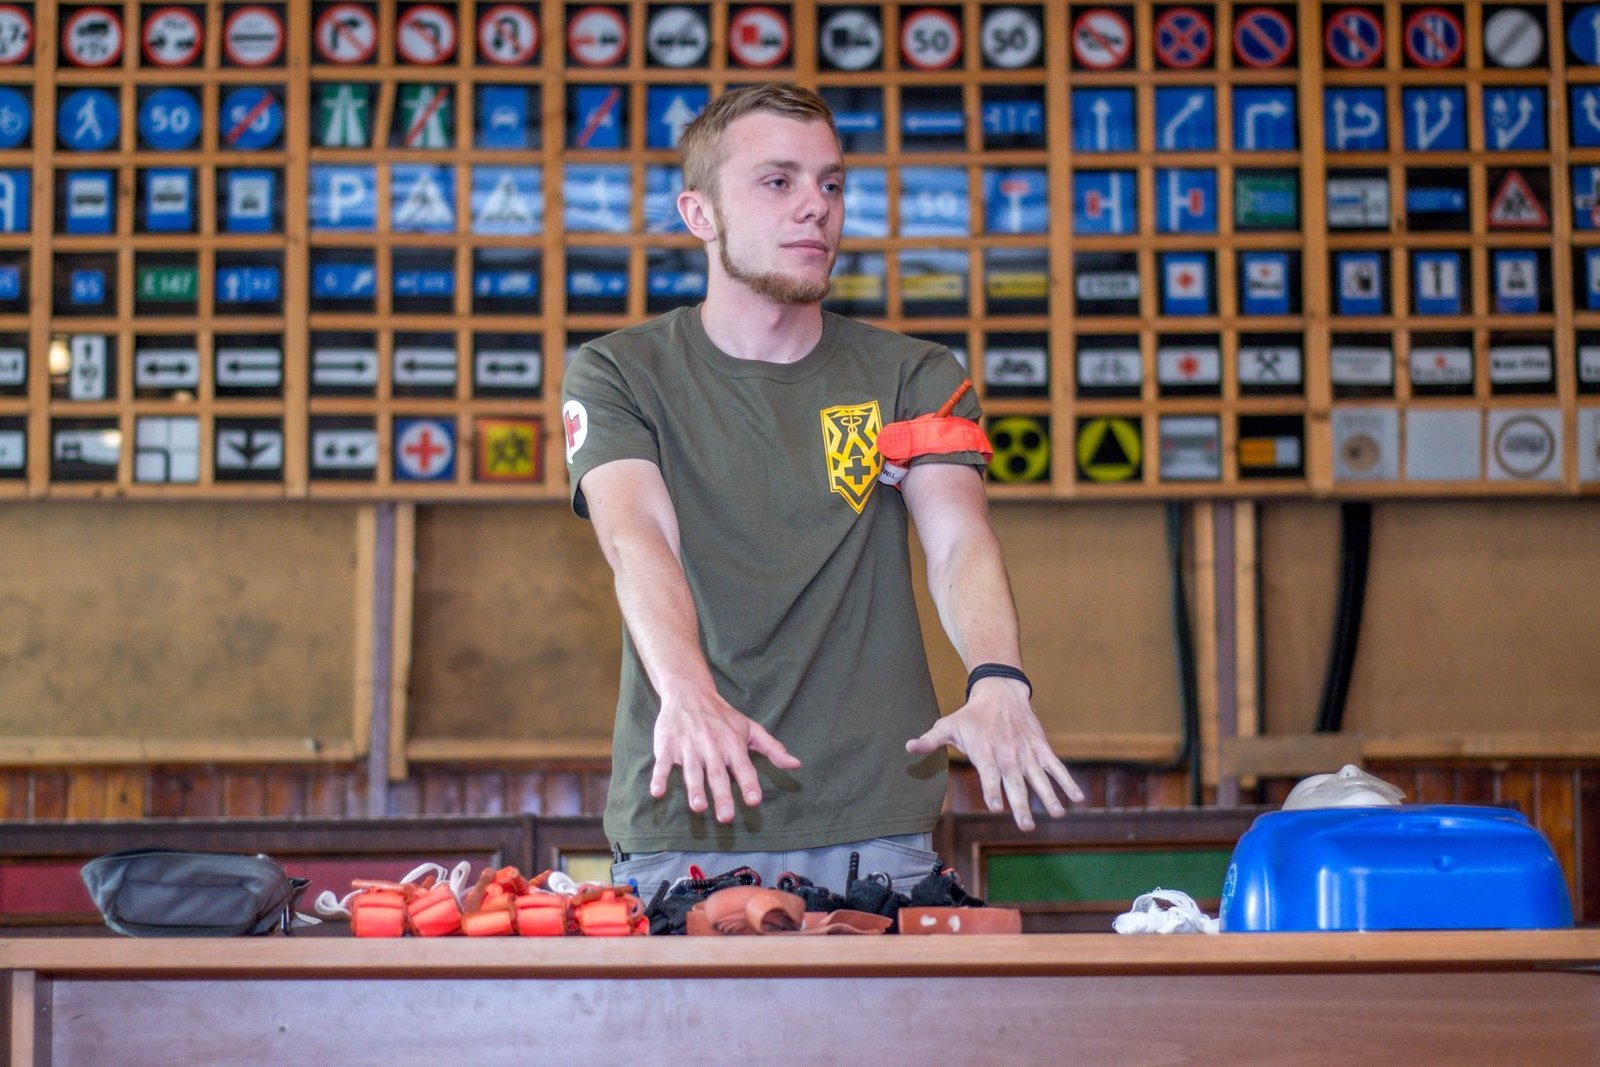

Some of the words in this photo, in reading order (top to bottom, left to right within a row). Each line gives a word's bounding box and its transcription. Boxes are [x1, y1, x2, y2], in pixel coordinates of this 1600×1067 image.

[912, 30, 950, 53] 50
[991, 27, 1028, 53] 50
[150, 106, 191, 133] 50
